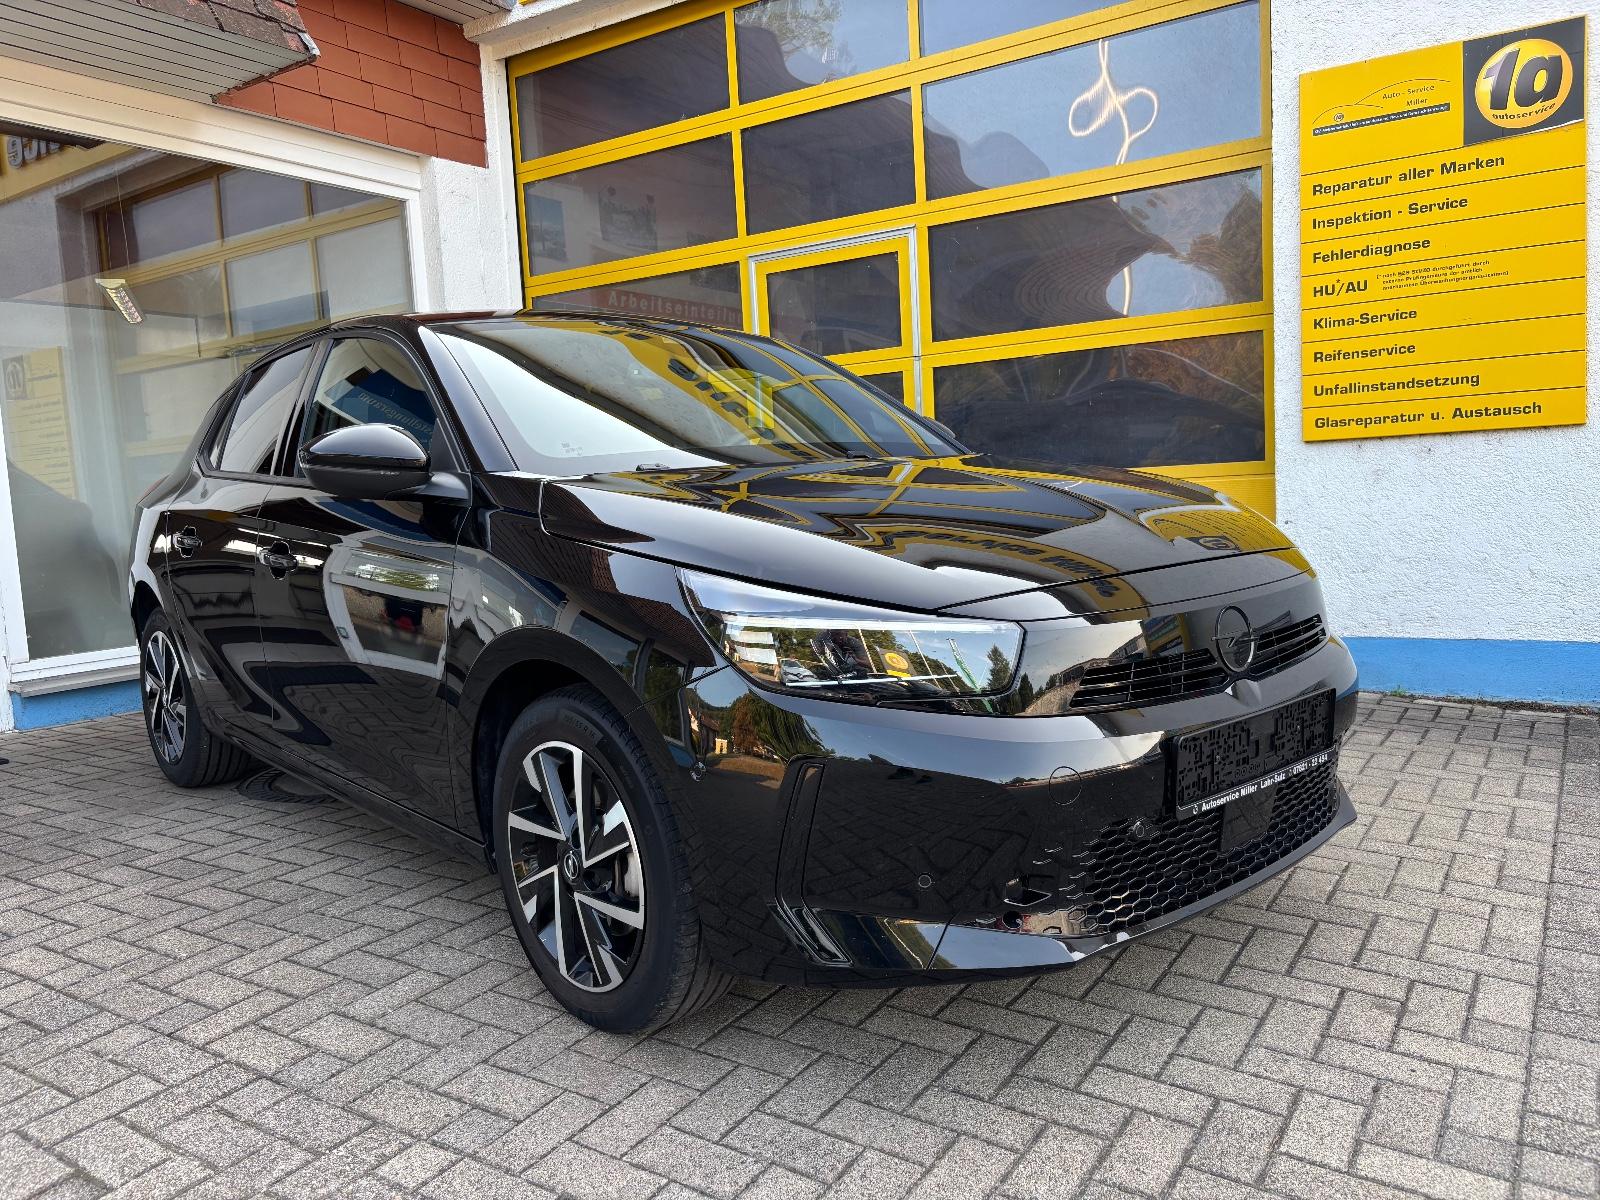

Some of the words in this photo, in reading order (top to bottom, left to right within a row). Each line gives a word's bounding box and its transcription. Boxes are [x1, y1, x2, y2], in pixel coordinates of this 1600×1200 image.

[1483, 48, 1563, 110] 1a
[1382, 90, 1400, 100] Auto
[1407, 84, 1435, 95] Service
[1406, 97, 1428, 107] Miller
[1491, 102, 1556, 121] autoservice
[1312, 174, 1393, 196] Reparatur
[1398, 166, 1435, 182] aller
[1440, 155, 1505, 176] Marken
[1312, 209, 1392, 230] Inspektion
[1408, 197, 1468, 215] Service
[1312, 238, 1431, 264] Fehlerdiagnose
[1313, 309, 1417, 330] Klima-Service
[1313, 343, 1416, 363] Reifenservice
[1313, 374, 1480, 397] Unfallinstandsetzung
[1314, 411, 1425, 429] Glasreparatur
[1430, 410, 1445, 421] u.
[1451, 401, 1542, 420] Austausch
[1201, 790, 1239, 813] Autoservice
[1240, 783, 1258, 797] Miller
